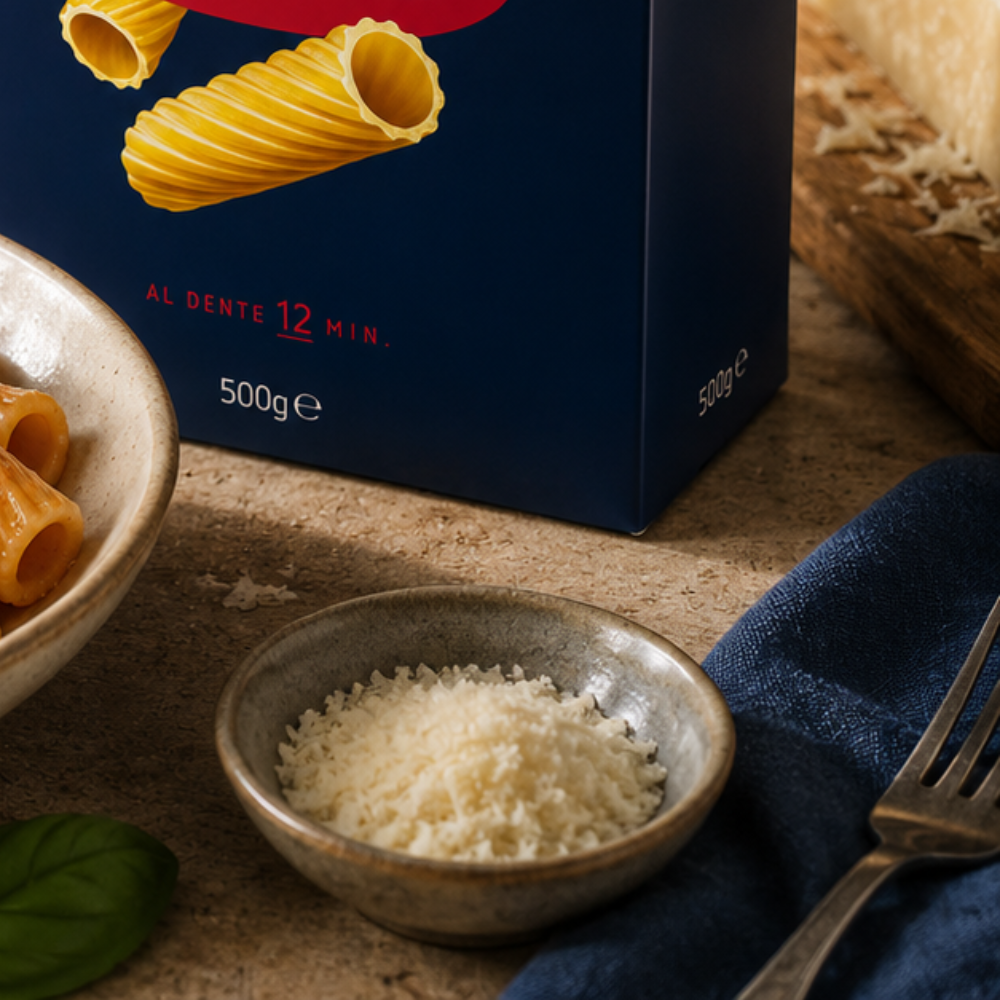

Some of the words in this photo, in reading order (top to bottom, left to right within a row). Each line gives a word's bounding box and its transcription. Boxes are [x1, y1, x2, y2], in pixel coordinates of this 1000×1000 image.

[146, 283, 174, 305] AL
[186, 290, 264, 324] DENTE
[276, 299, 313, 336] 12
[326, 317, 391, 348] MIN.
